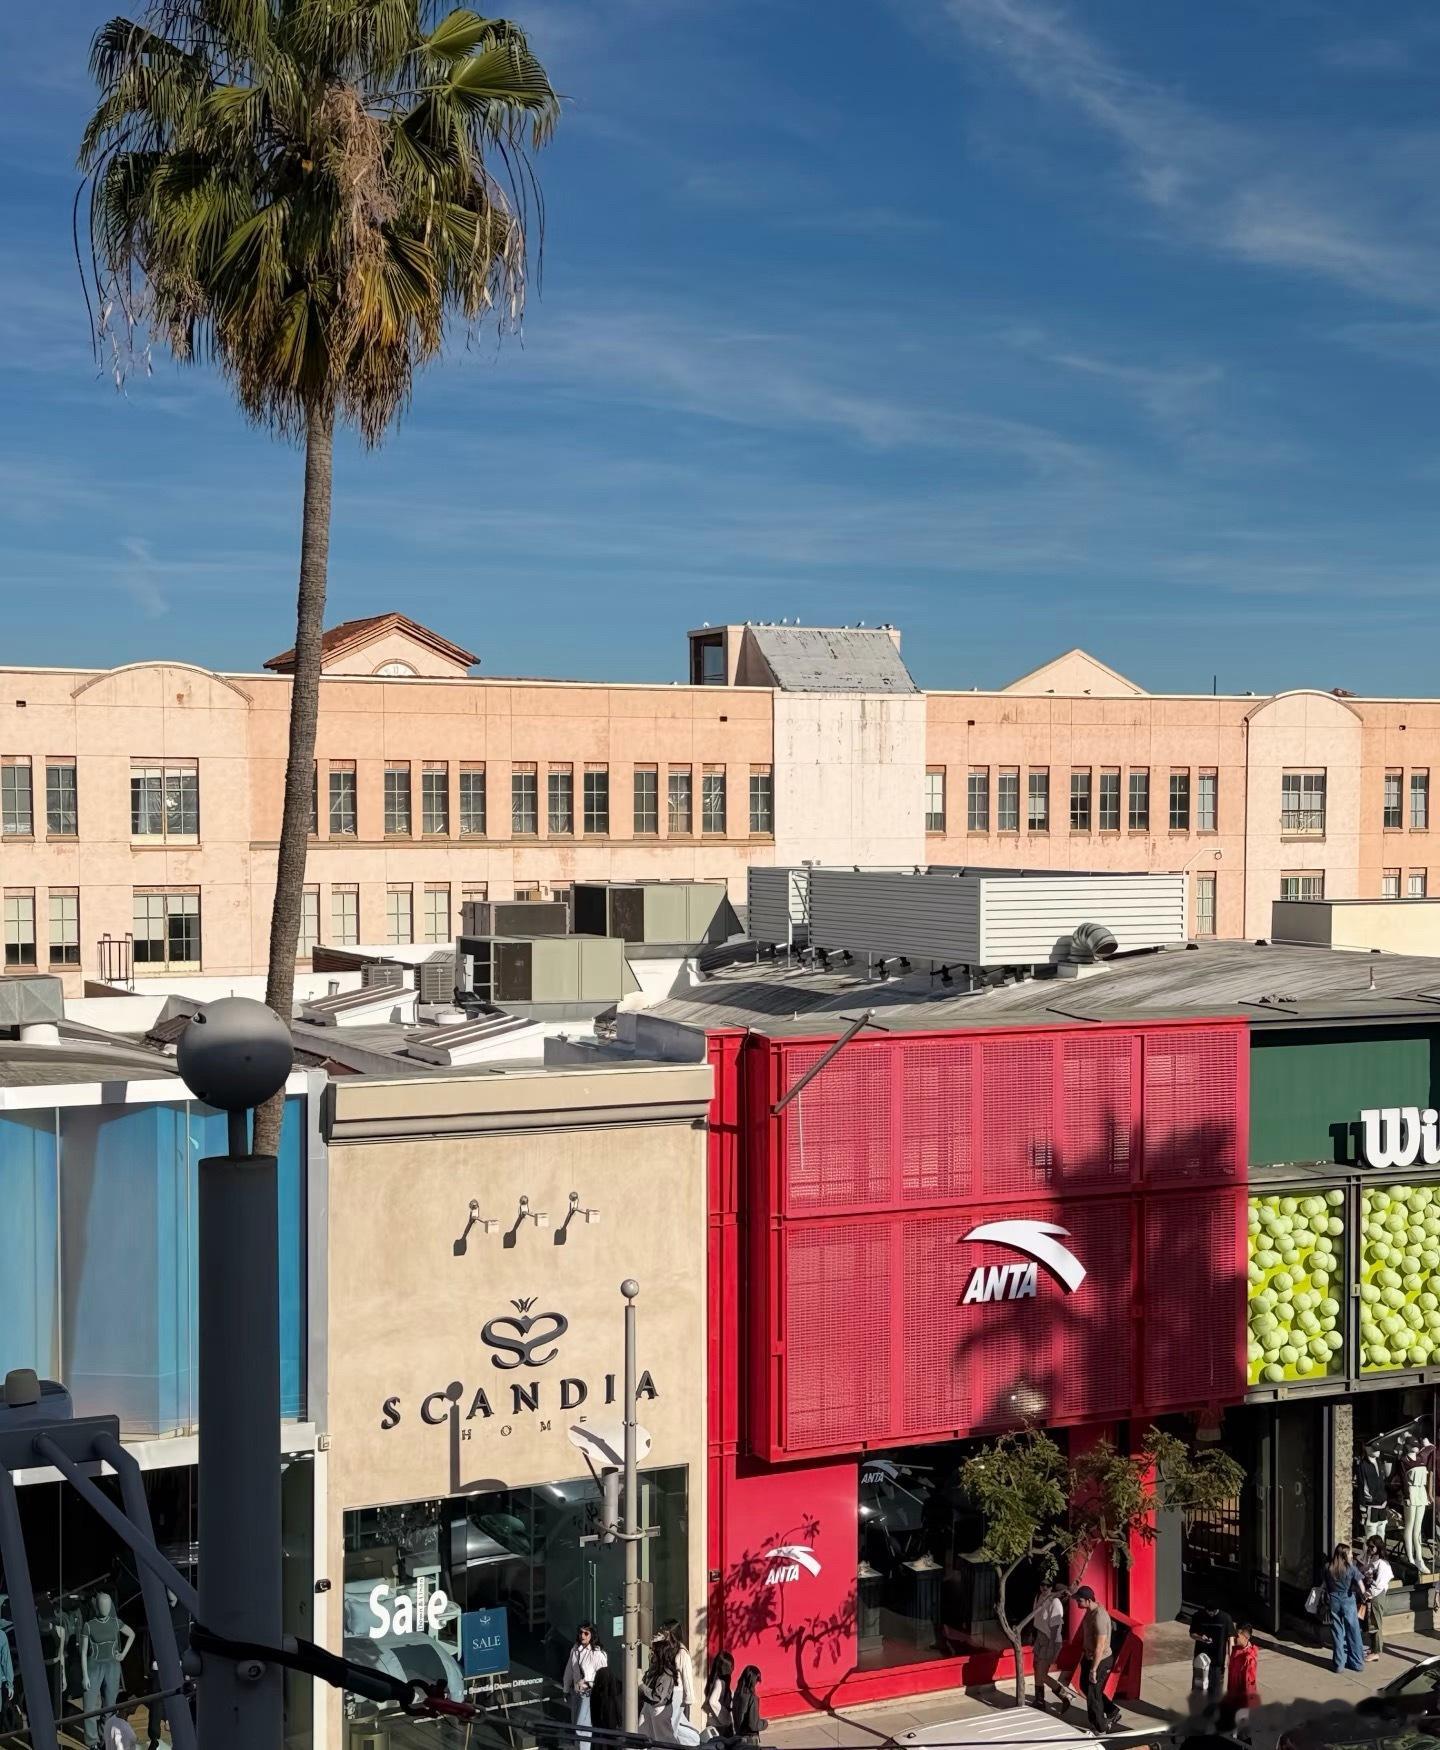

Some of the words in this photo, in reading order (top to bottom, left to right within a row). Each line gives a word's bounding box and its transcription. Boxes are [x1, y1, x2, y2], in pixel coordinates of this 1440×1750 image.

[1361, 1106, 1440, 1168] Wi
[962, 1262, 1038, 1304] ANTA
[381, 1370, 660, 1430] SCANDIA
[861, 1471, 884, 1484] ANTA
[764, 1564, 799, 1586] ANTA
[369, 1576, 448, 1639] Sale
[472, 1635, 500, 1649] SALE
